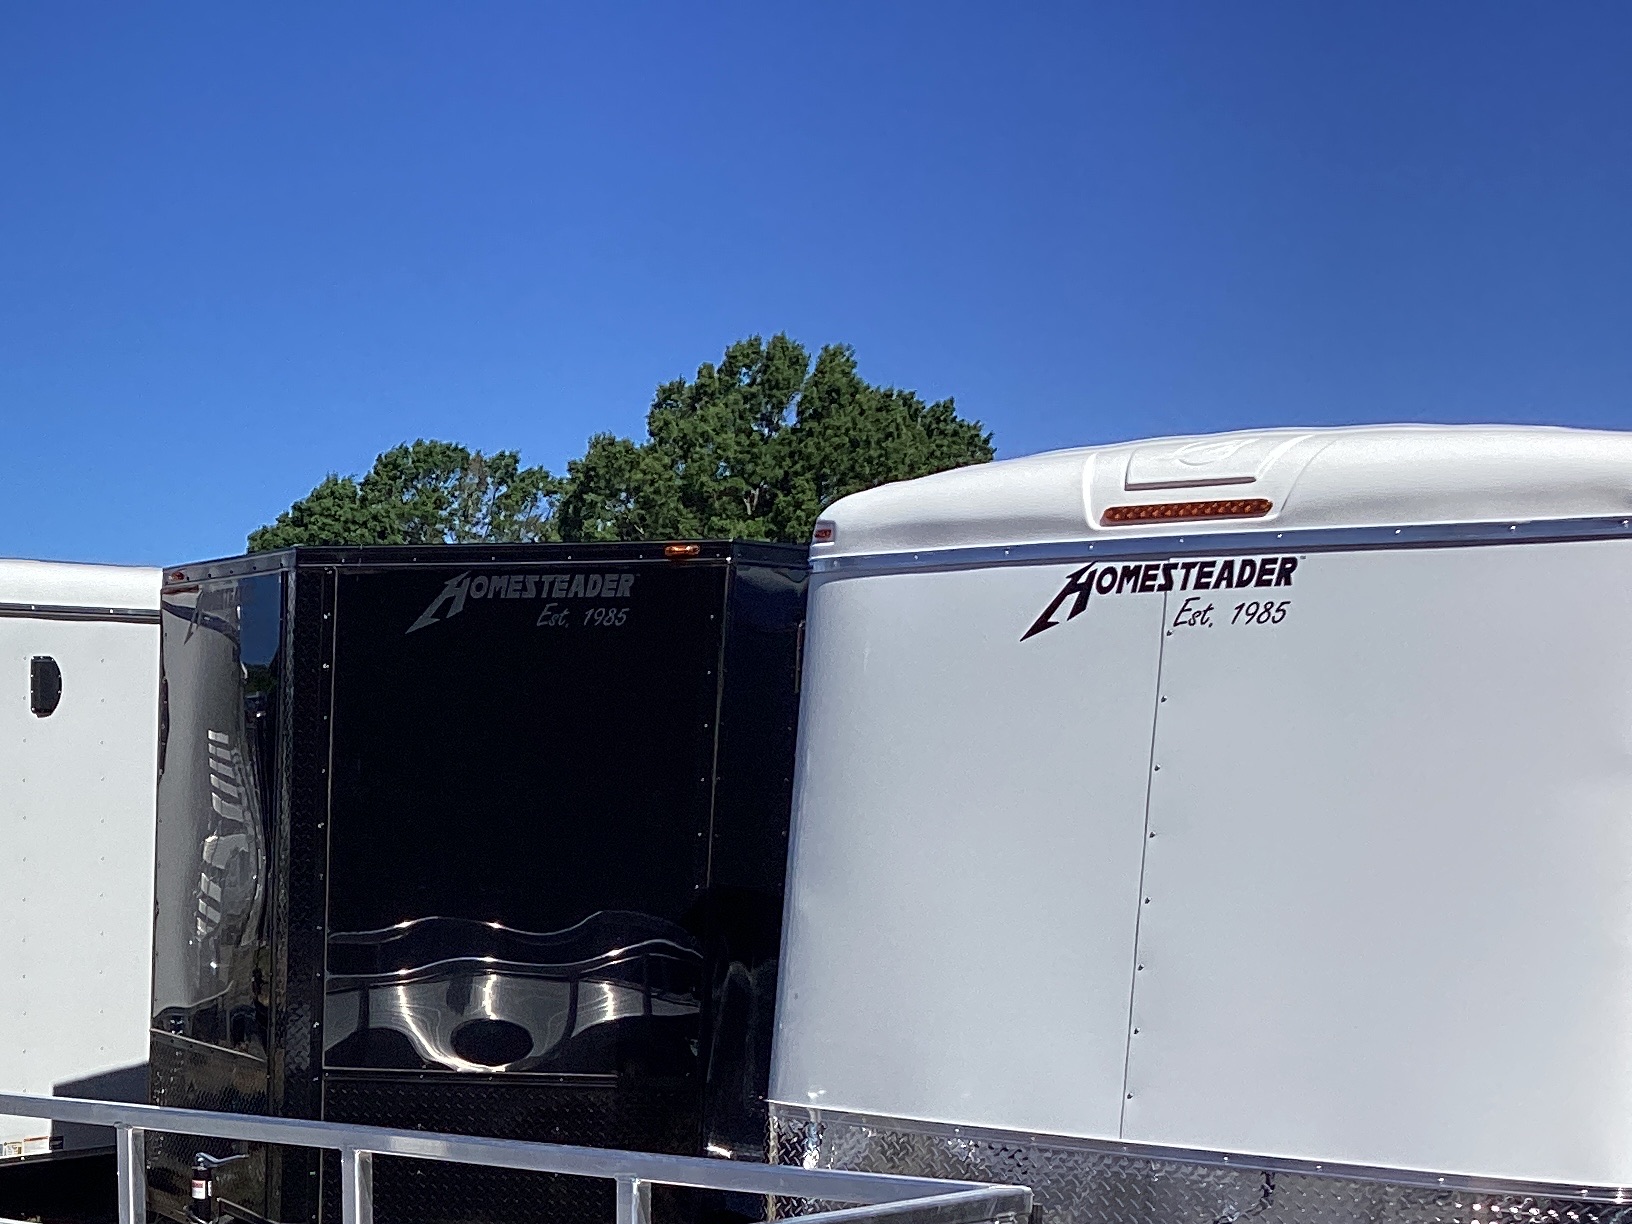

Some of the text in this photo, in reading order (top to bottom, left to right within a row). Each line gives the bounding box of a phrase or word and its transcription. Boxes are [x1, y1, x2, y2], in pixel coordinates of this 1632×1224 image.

[405, 570, 634, 634] HOMESTEADER
[583, 607, 630, 627] 1985
[1019, 556, 1299, 642] HOMESTEADER
[1173, 597, 1291, 628] Est. 1985
